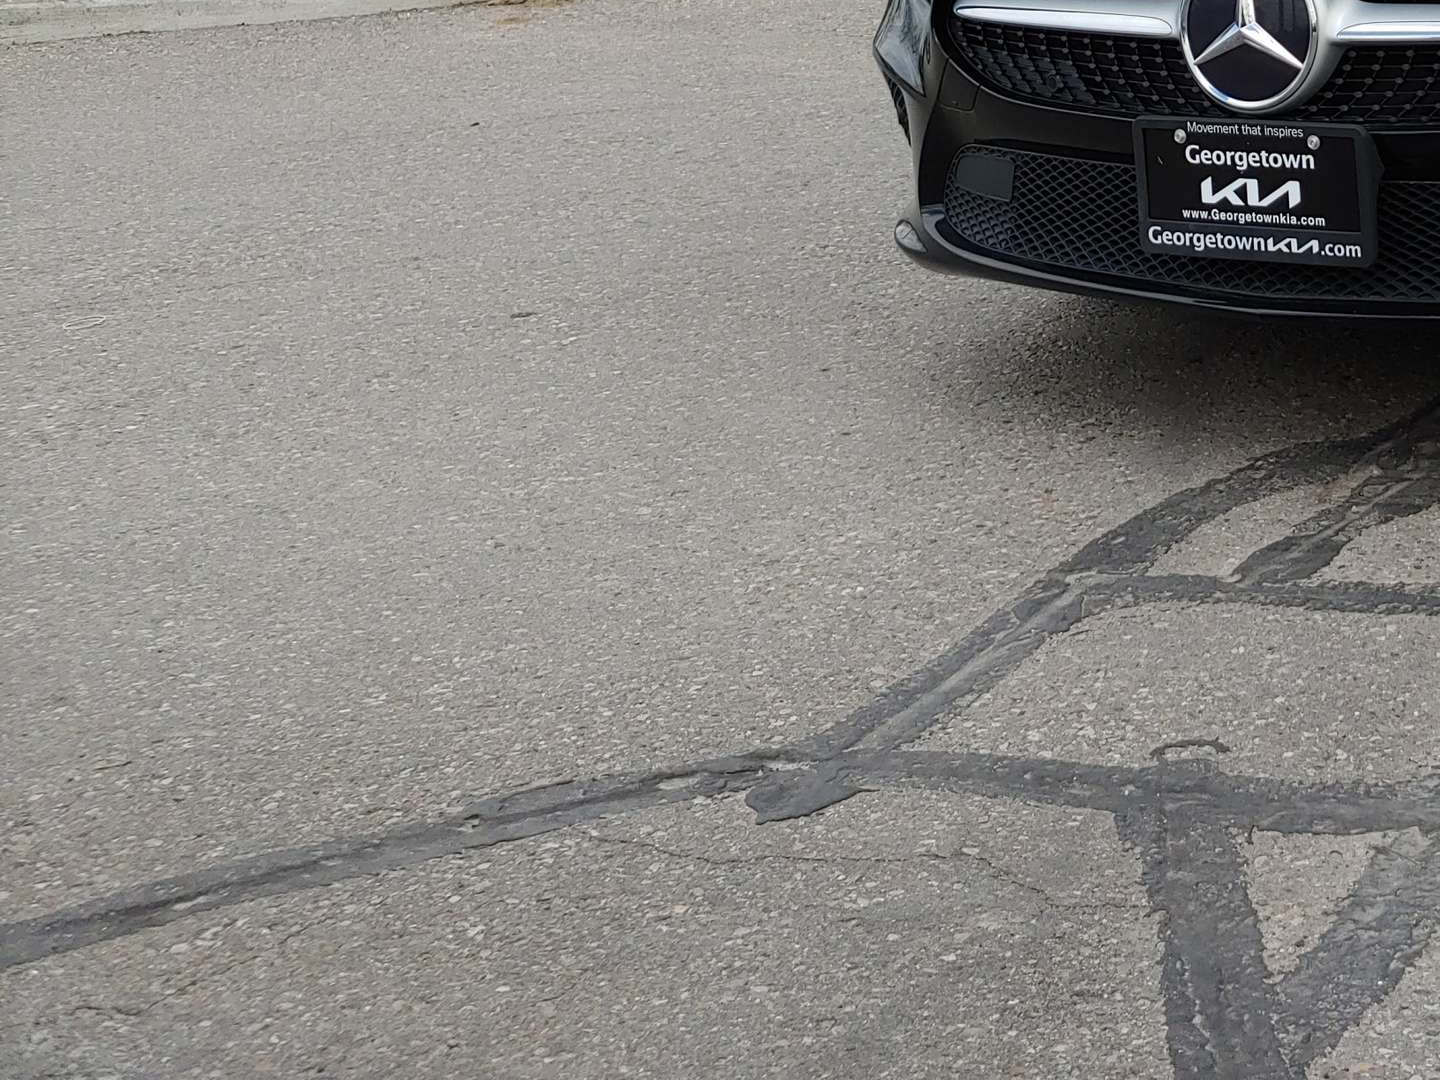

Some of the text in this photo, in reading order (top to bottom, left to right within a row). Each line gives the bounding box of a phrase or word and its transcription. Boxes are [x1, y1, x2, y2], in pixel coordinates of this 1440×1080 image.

[1186, 121, 1304, 139] Movement that inspires
[1185, 144, 1316, 171] Georgetown
[1200, 175, 1302, 209] KIA
